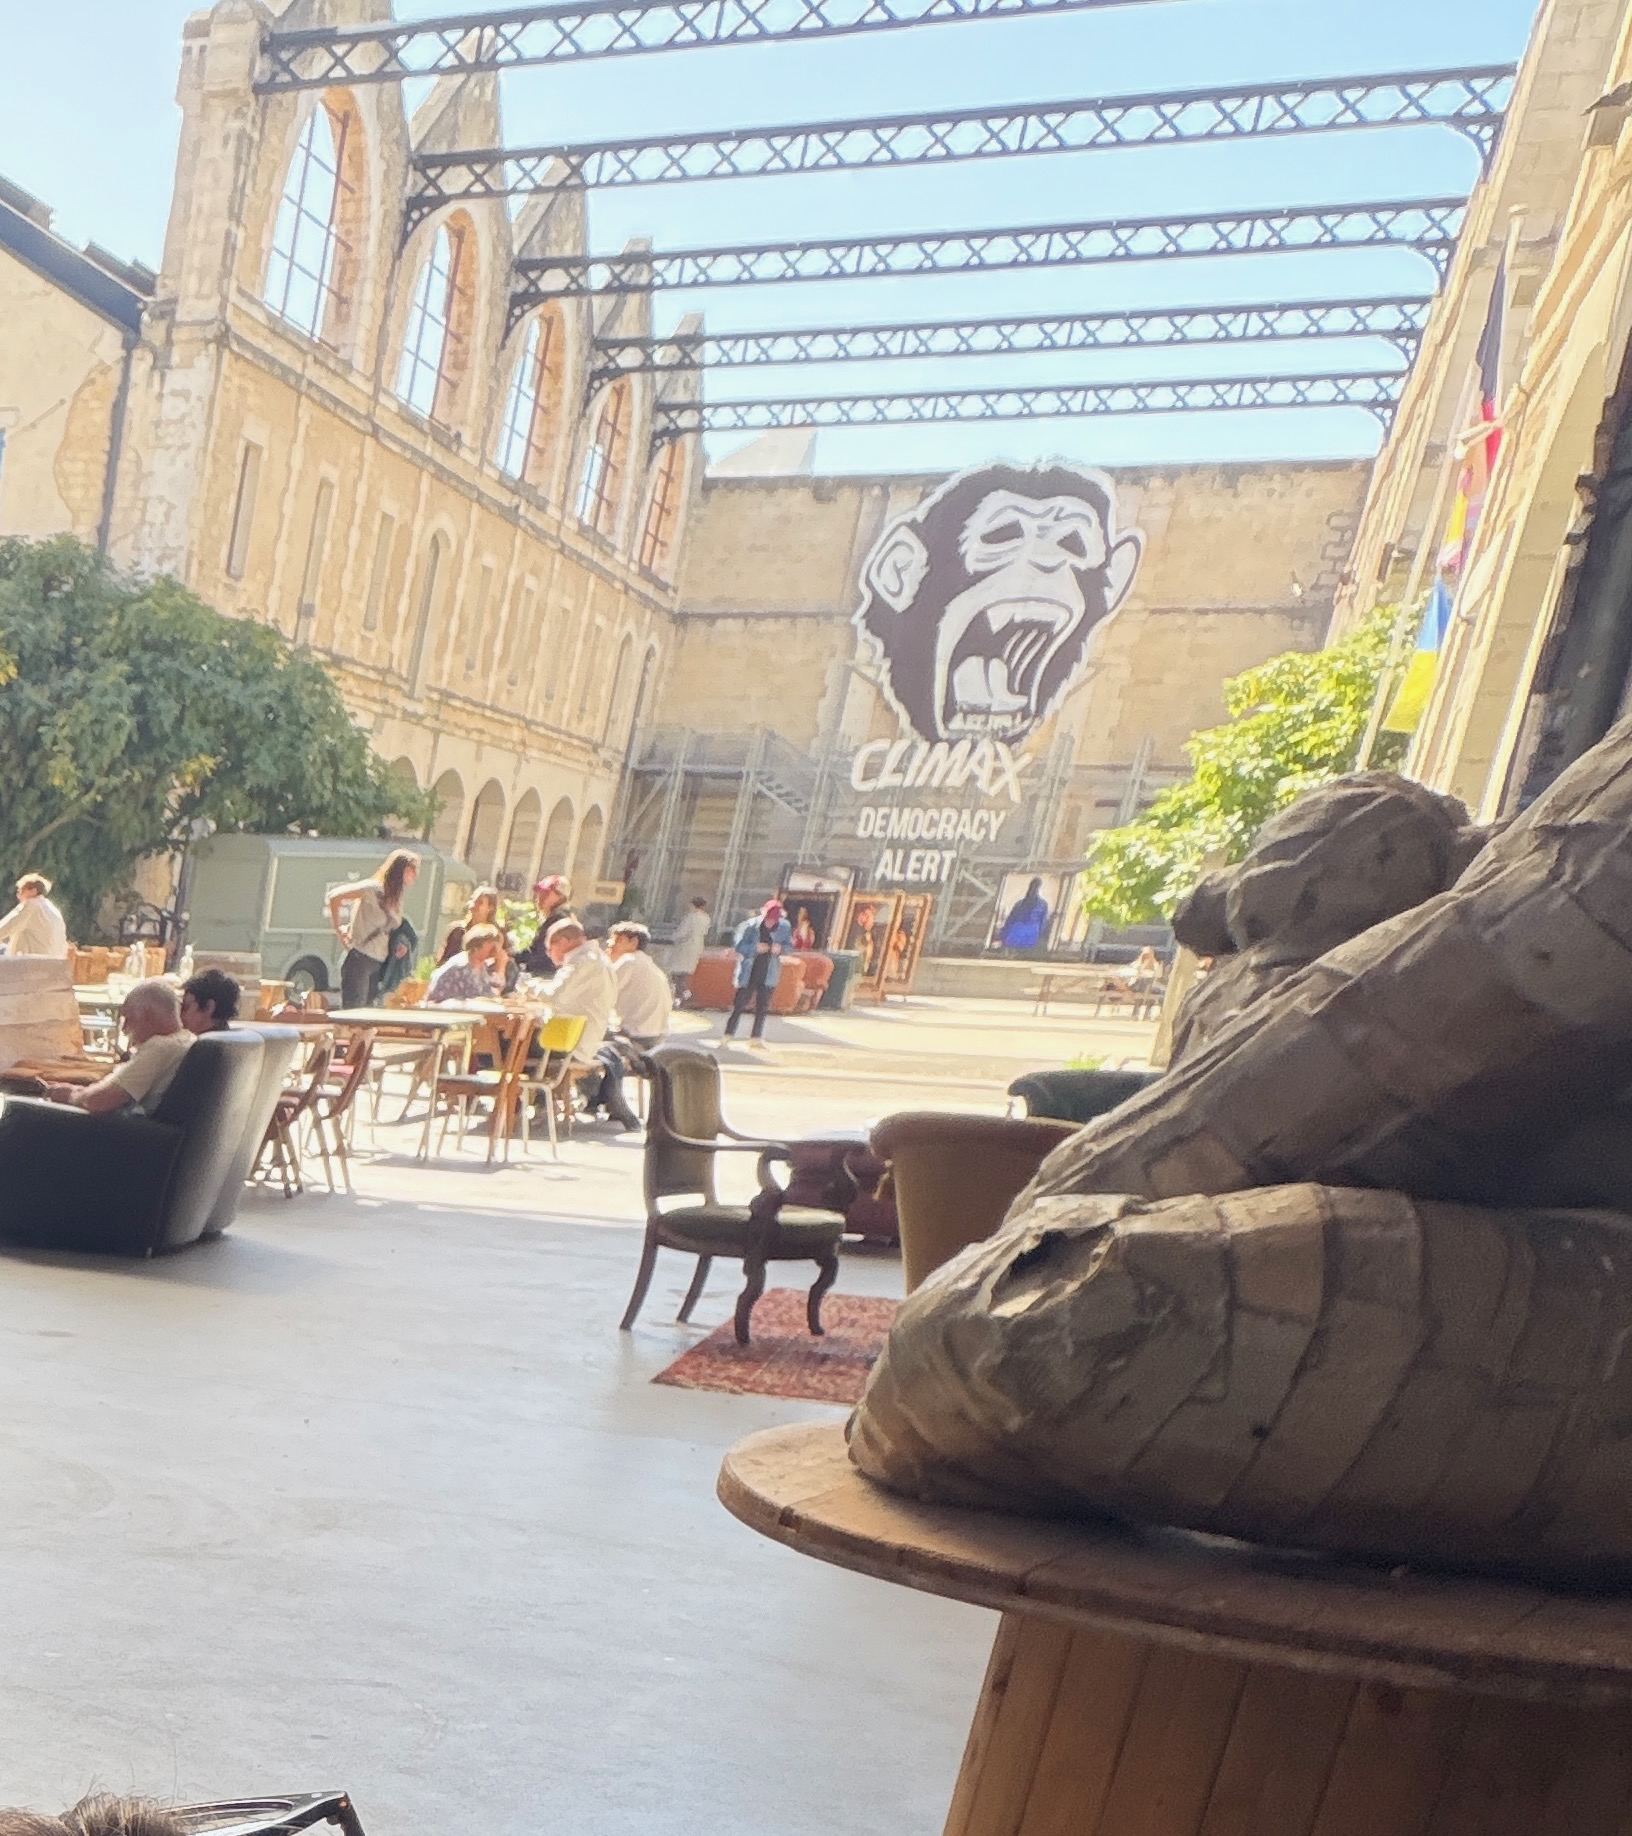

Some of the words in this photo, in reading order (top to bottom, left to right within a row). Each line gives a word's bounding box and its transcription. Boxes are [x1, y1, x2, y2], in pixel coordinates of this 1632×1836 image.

[852, 738, 1033, 803] CLIMAX
[858, 807, 1006, 841] DEMOCRACY
[876, 849, 957, 883] ALERT
